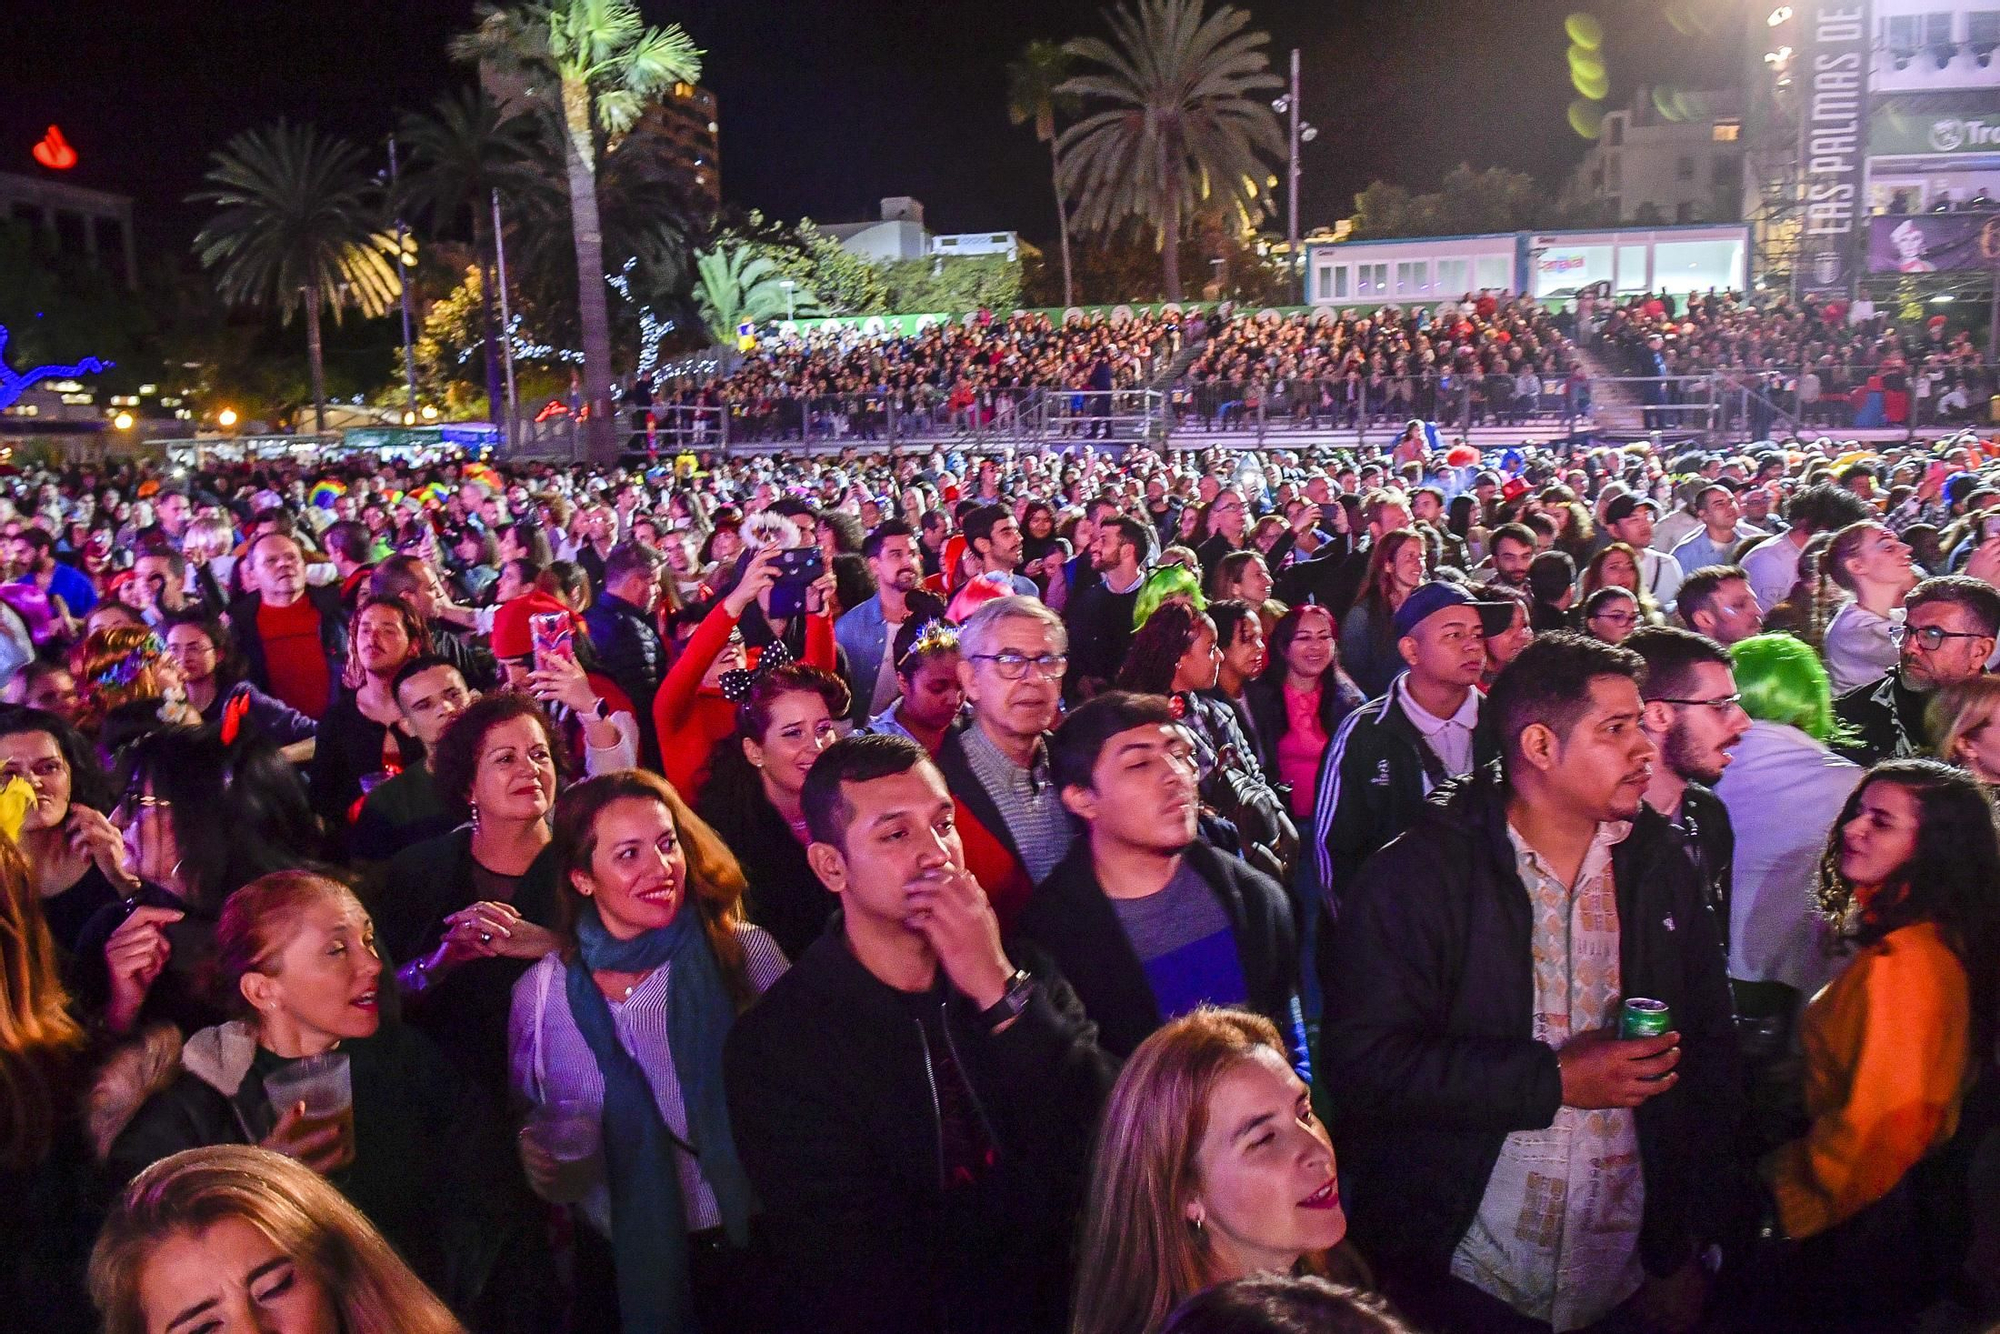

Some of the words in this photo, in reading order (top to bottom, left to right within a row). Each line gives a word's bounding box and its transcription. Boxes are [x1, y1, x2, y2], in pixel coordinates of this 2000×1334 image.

[1816, 6, 1863, 42] DE
[1809, 51, 1861, 173] PALMAS
[1807, 183, 1856, 235] LAS
